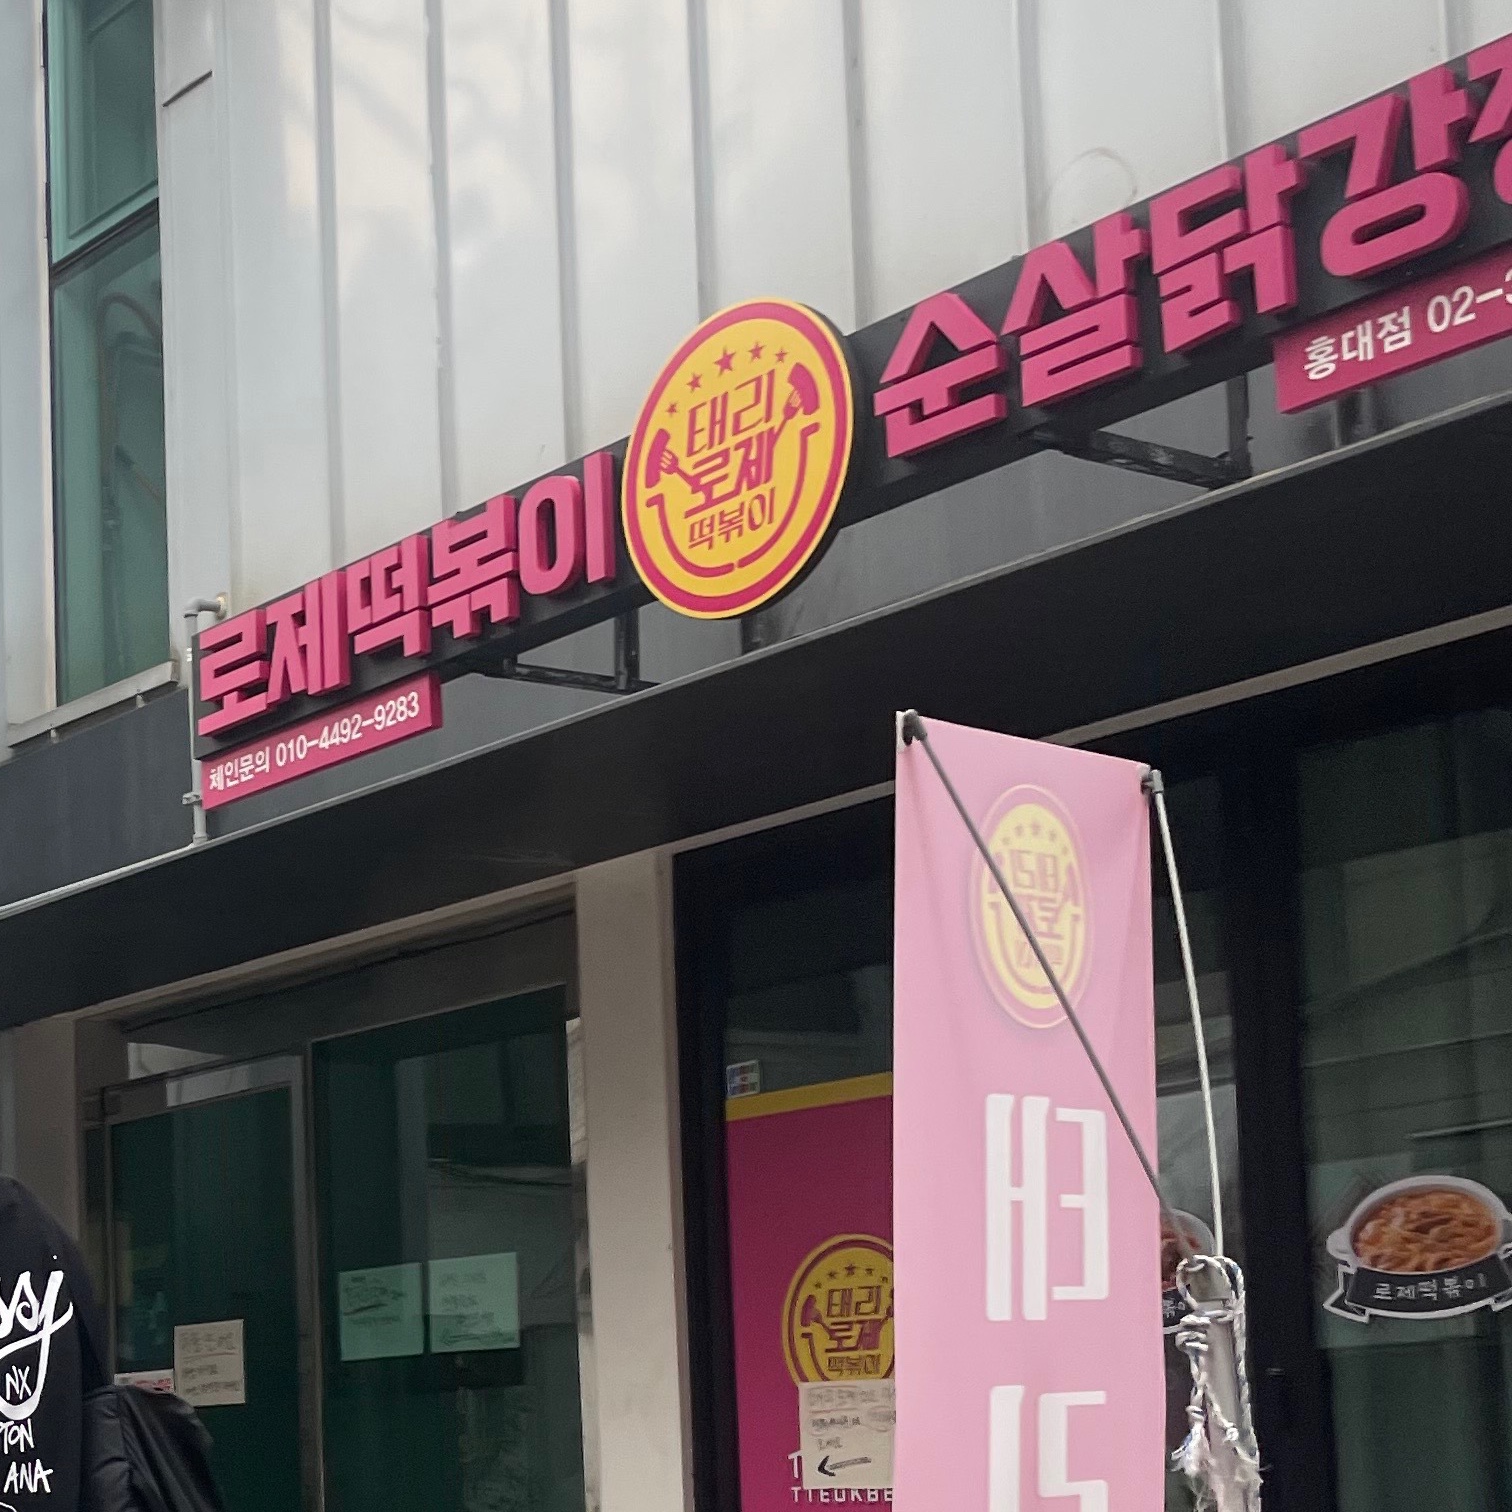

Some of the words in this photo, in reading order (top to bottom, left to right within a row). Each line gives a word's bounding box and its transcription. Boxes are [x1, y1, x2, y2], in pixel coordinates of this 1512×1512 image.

[874, 33, 1512, 458] 순살닭강
[1303, 305, 1412, 381] 홍대점
[686, 368, 776, 458] 태리
[688, 487, 776, 550] 떡볶이
[198, 451, 615, 737] 로제떡볶이
[208, 746, 271, 791] 체인문의
[275, 690, 420, 768] 010-4492-9283
[3, 1459, 53, 1494] ANA
